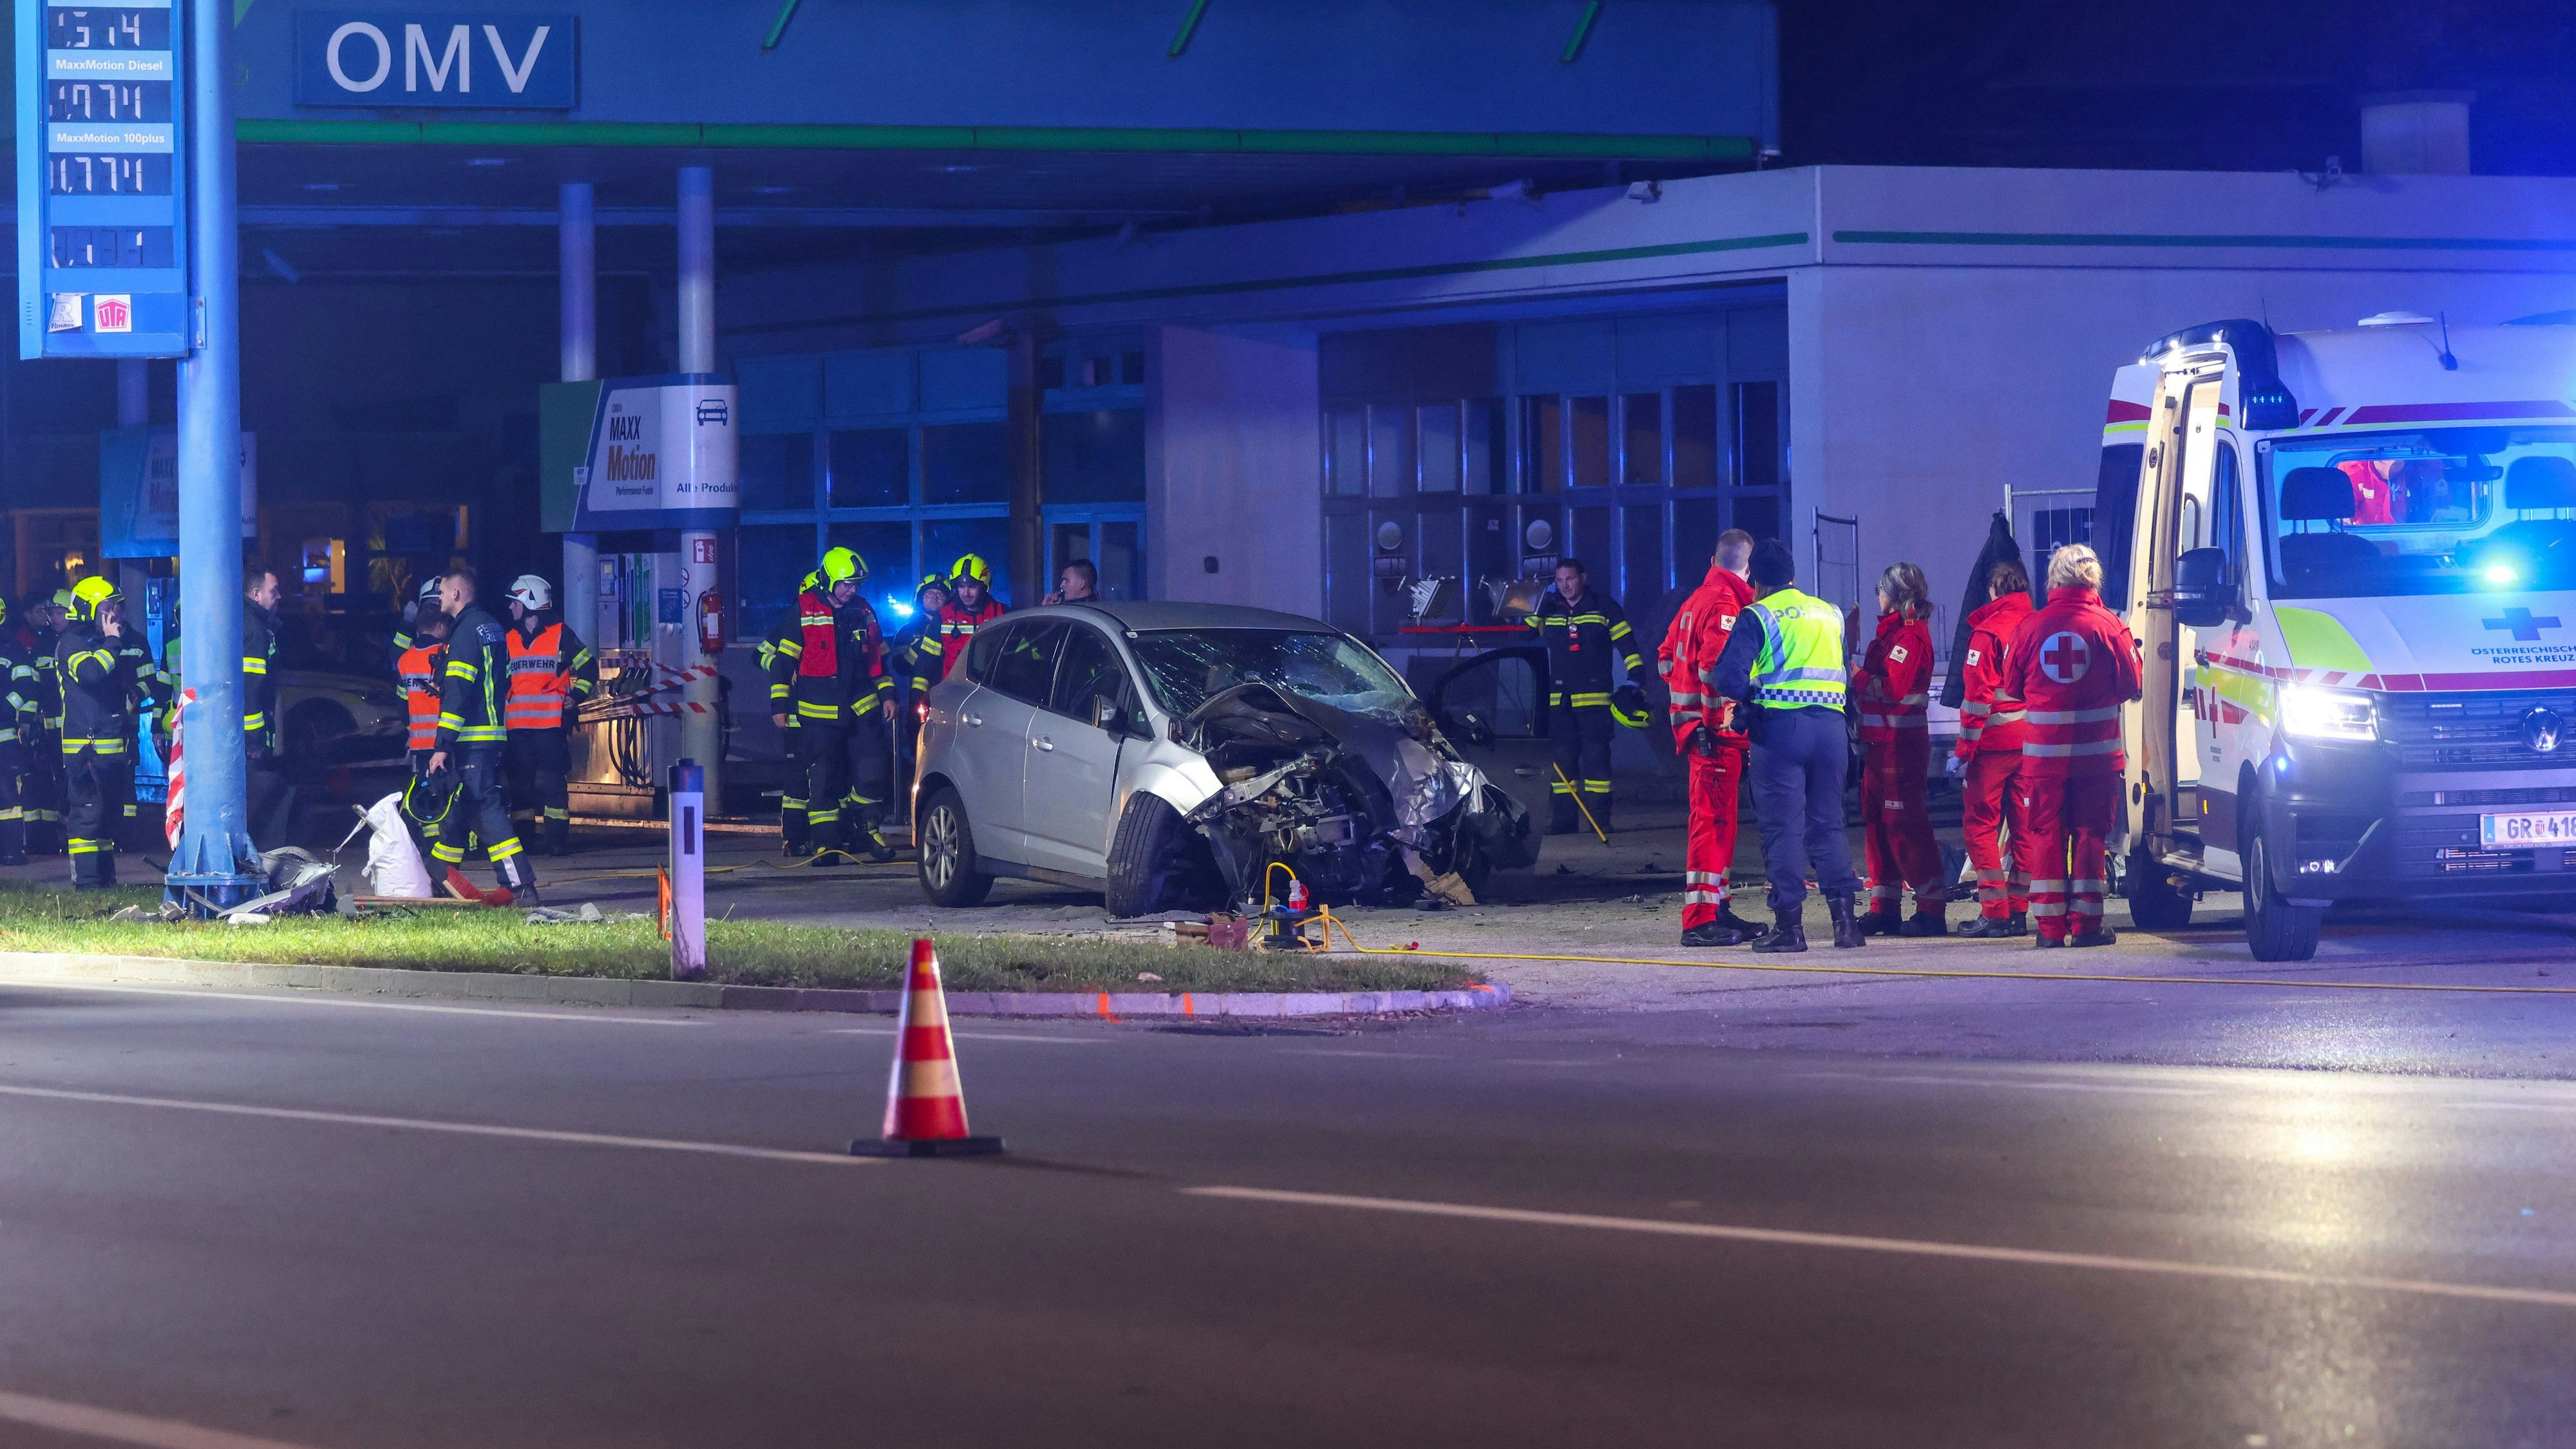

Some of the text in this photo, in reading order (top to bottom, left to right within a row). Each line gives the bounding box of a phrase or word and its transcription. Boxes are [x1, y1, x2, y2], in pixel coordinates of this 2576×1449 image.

[56, 59, 163, 70] MaxxMotion Diesel
[327, 21, 551, 93] OMV
[57, 133, 165, 145] MaxxMotion 100plus
[98, 301, 128, 327] UTA
[609, 415, 641, 441] MAXX
[607, 444, 656, 481] Motion
[2493, 654, 2575, 664] ROTES KREUZ
[2508, 818, 2532, 838] GR
